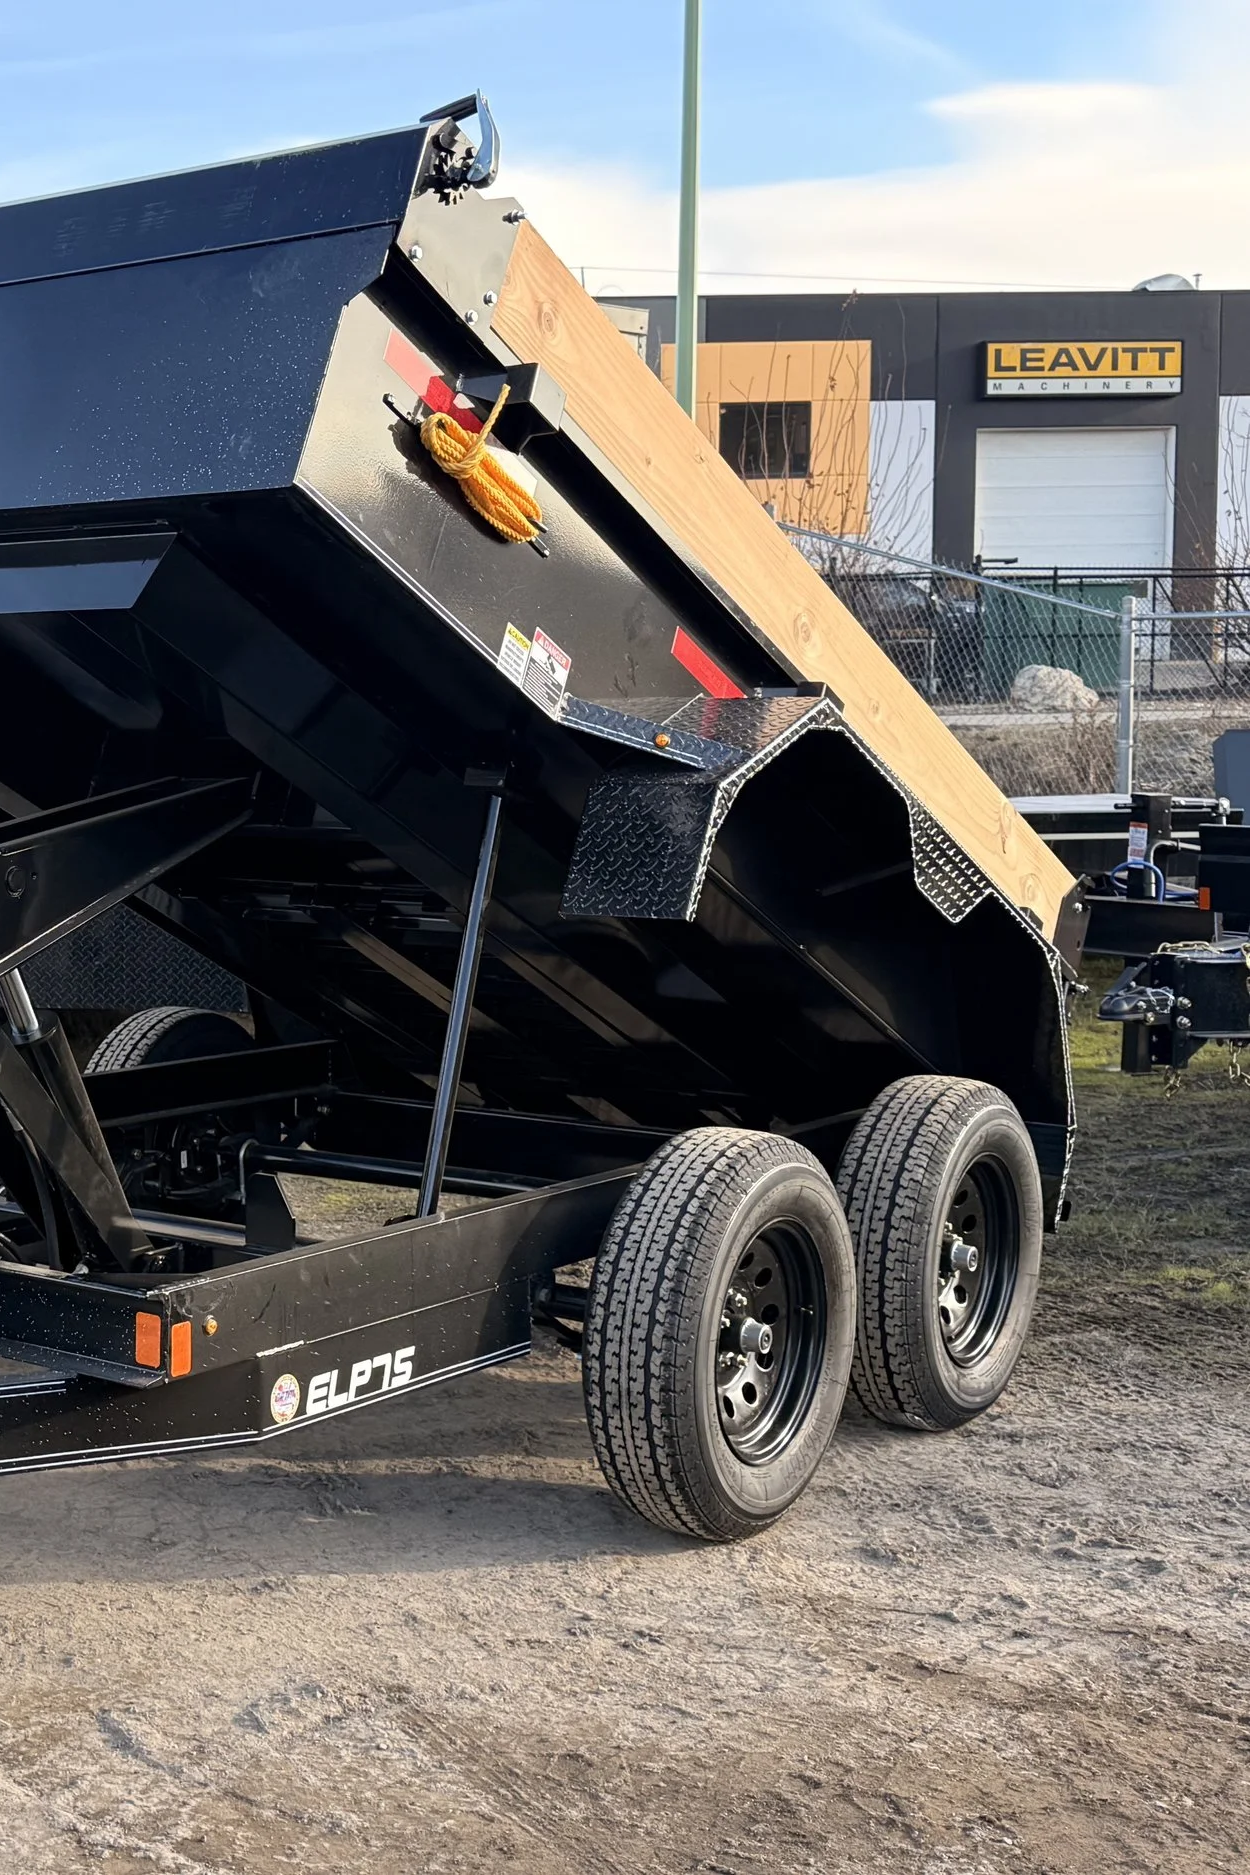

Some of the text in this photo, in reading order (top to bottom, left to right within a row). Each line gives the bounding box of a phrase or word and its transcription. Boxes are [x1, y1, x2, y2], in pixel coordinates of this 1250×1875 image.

[994, 347, 1175, 372] LEAVITT
[993, 381, 1175, 391] MACHINERY
[544, 642, 568, 666] DANGER
[306, 1345, 416, 1414] ELP75
